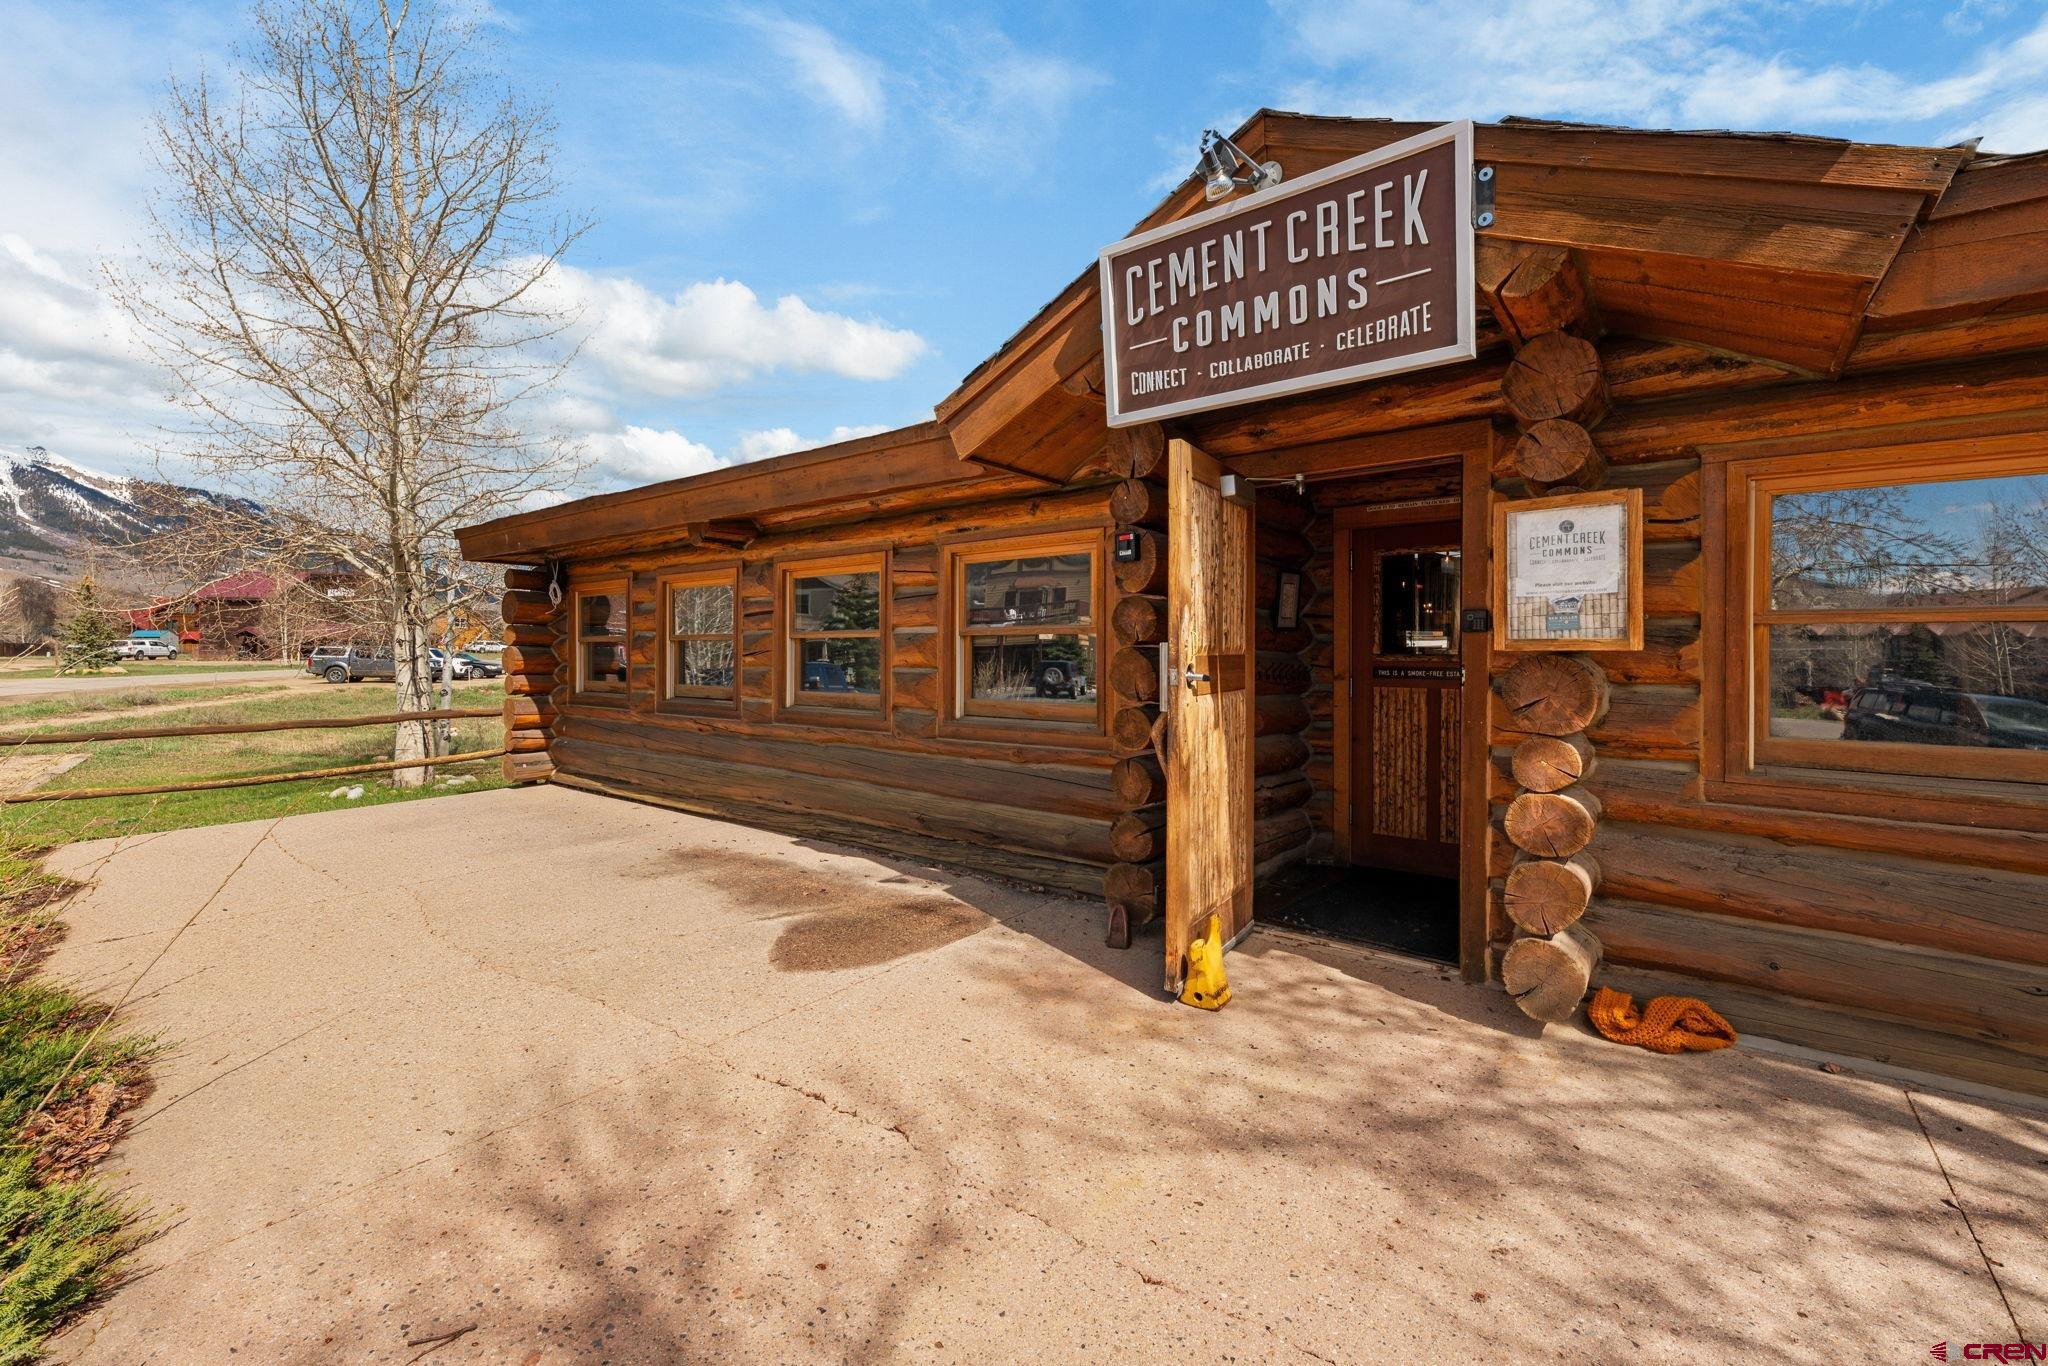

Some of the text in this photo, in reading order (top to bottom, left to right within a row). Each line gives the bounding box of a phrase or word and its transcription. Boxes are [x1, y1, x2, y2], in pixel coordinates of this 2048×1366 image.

[1125, 169, 1428, 326] CEMENT CREEK
[1131, 302, 1432, 395] CONNECT COLLABORATE CELEBRATE
[1173, 268, 1368, 353] COMMONS
[1529, 531, 1606, 550] CEMENT CREEK
[1542, 546, 1592, 557] COMMONS
